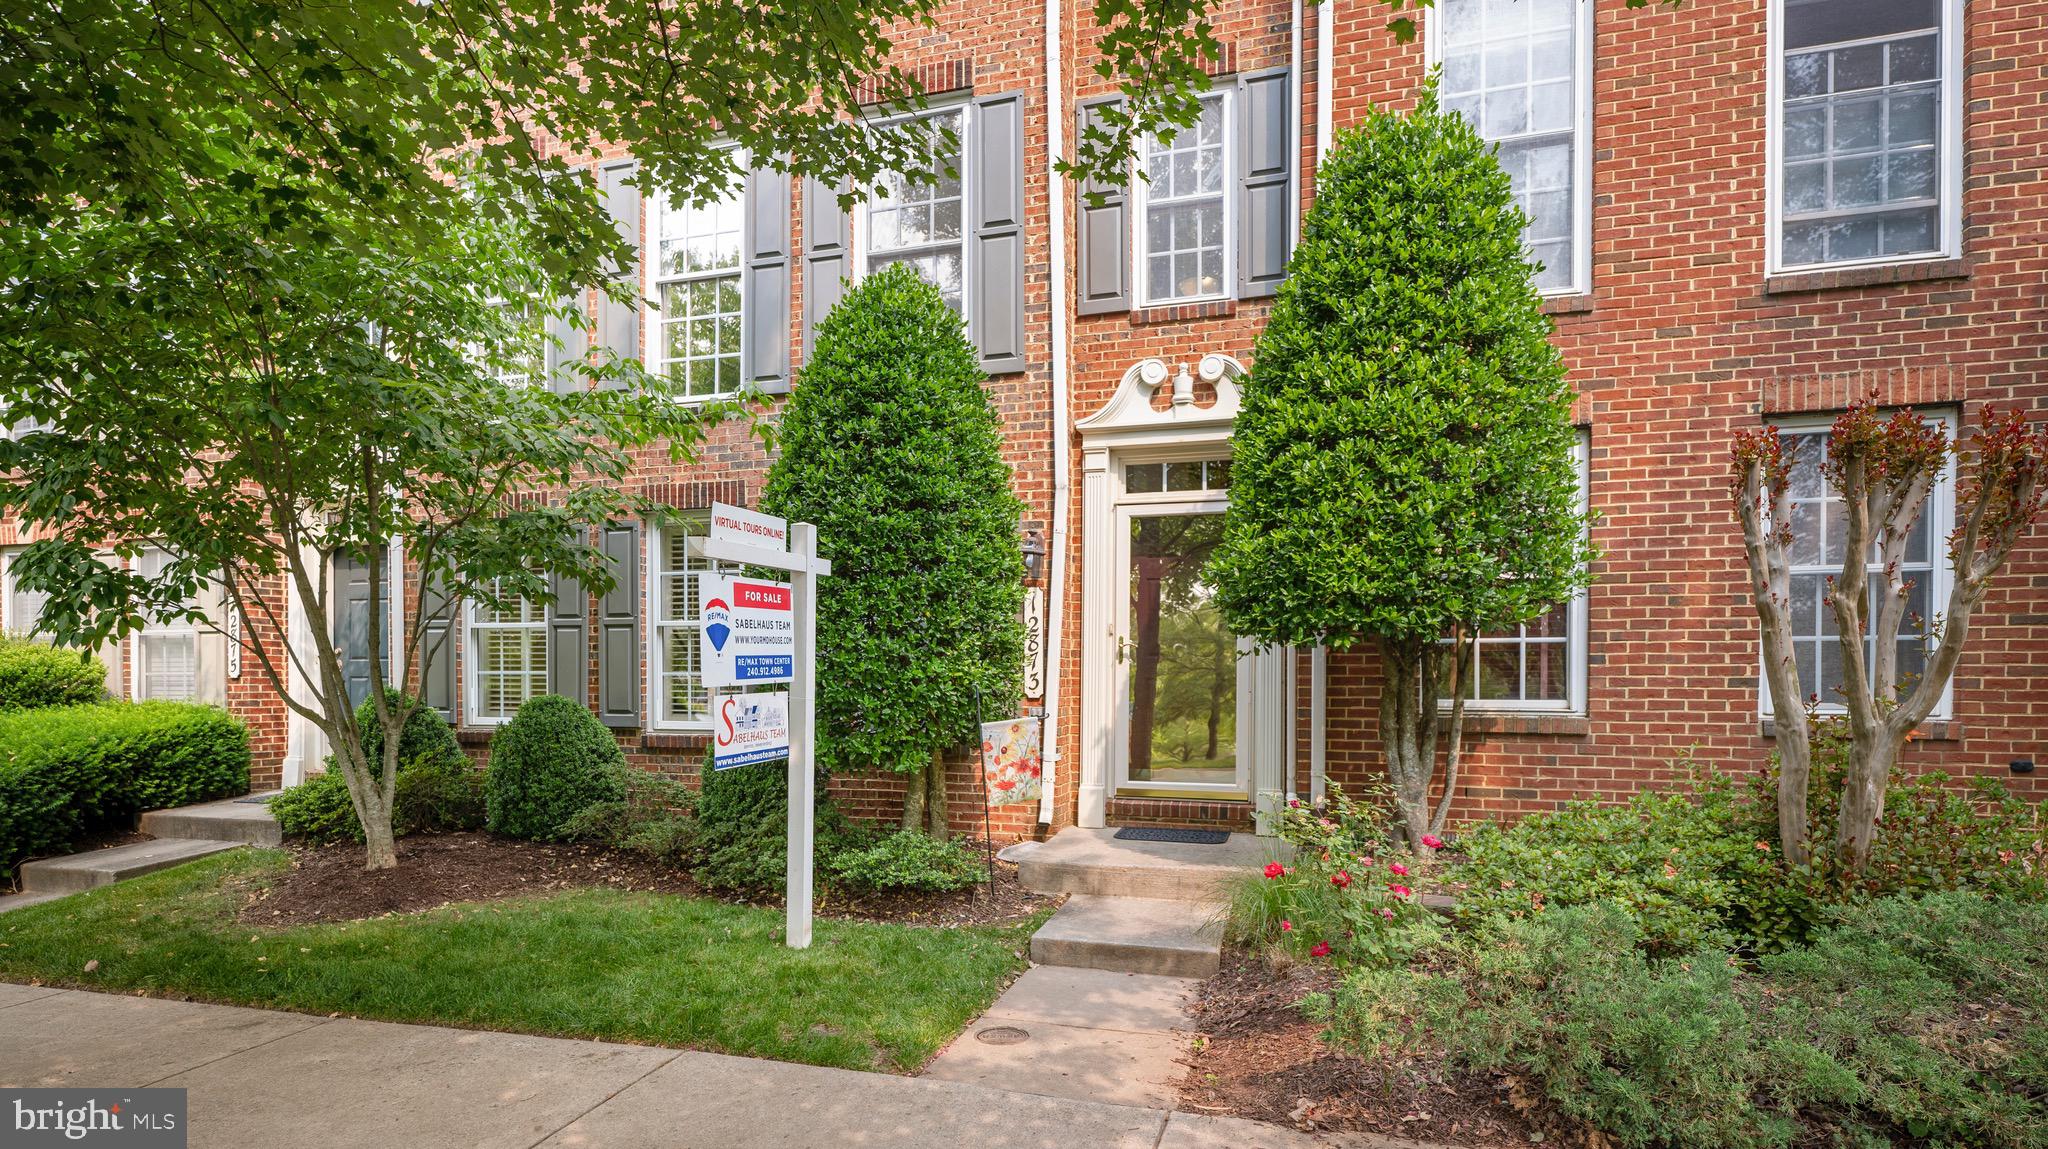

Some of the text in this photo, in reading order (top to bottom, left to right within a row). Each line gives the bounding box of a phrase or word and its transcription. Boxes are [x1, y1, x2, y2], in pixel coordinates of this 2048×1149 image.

[714, 515, 785, 540] VIRTUAL TOURS ONLINE!
[745, 590, 782, 604] FOR SALE
[707, 612, 729, 622] RE/MAX
[735, 618, 791, 630] SABELHAUS TEAM
[1027, 590, 1040, 691] 12873
[737, 656, 791, 667] RE/MAX TOWN CENTER
[716, 749, 788, 767] www.sabelhausteam.com
